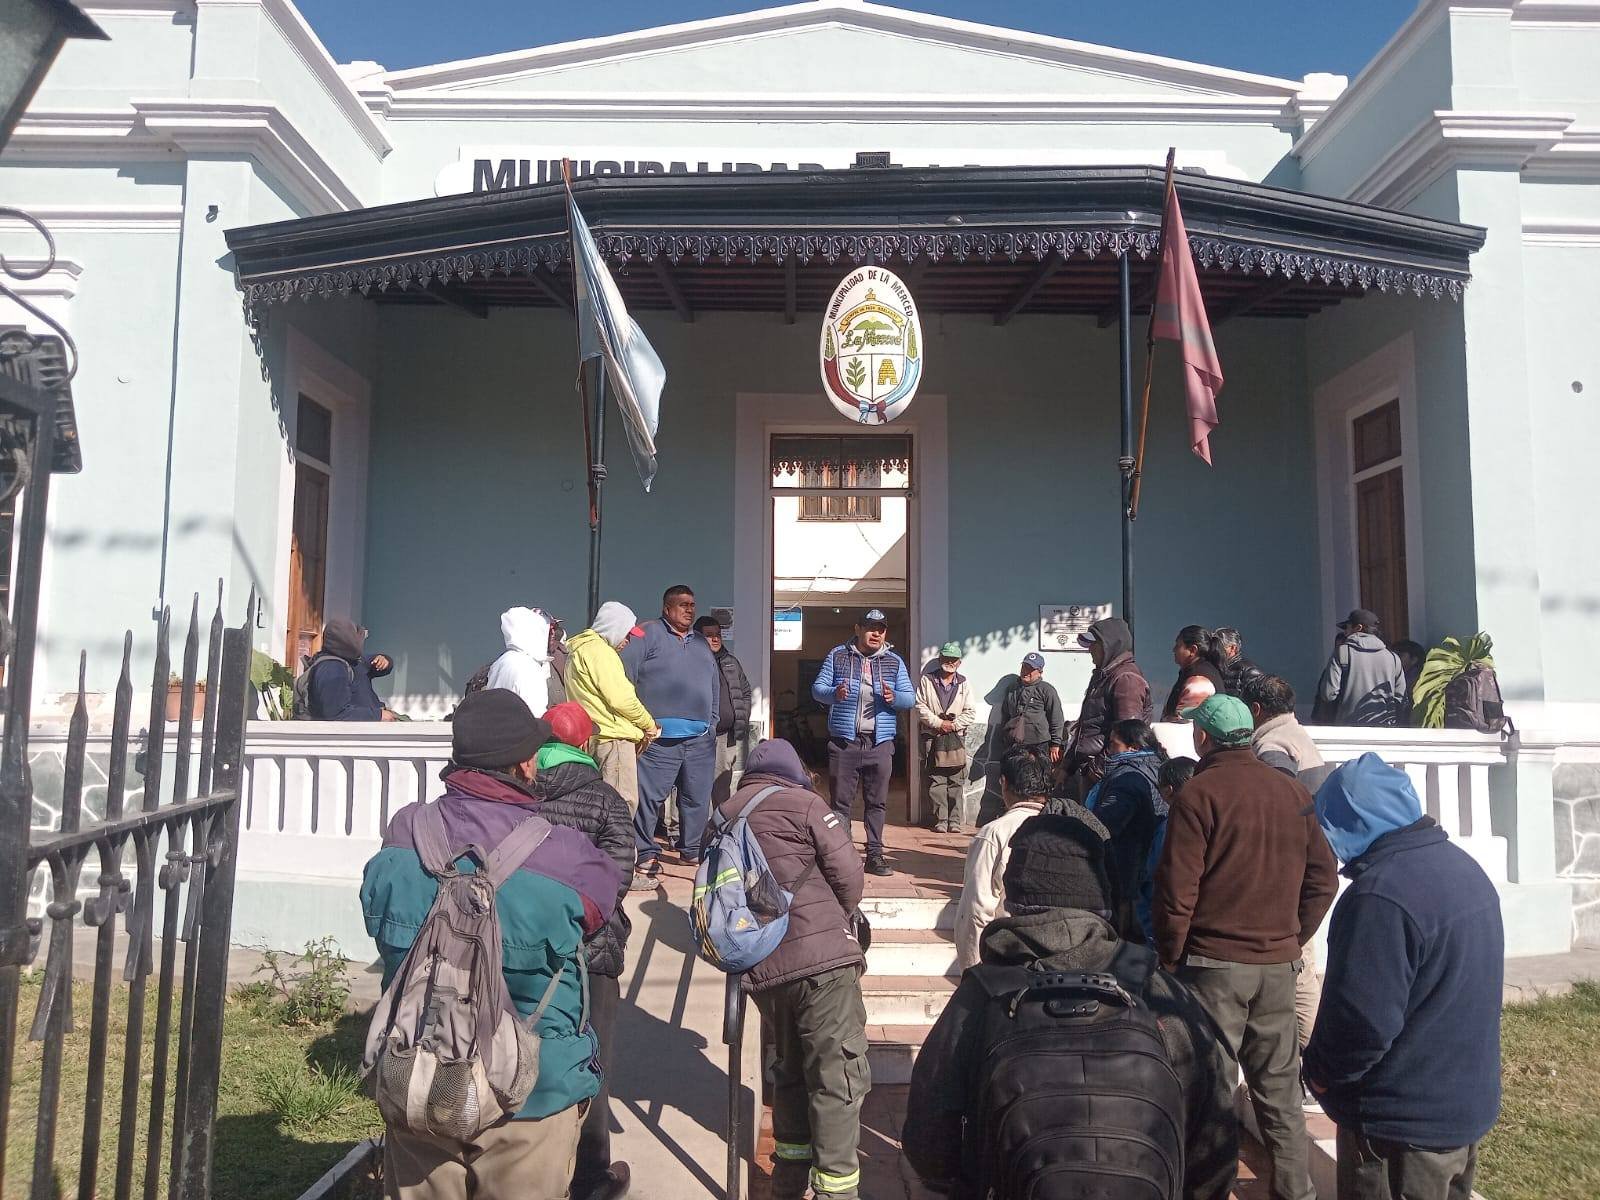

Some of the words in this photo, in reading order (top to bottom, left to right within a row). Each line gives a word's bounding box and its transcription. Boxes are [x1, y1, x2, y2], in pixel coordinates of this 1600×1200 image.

[828, 273, 864, 319] MUNICIPALIDAD
[868, 269, 878, 280] DE
[880, 272, 890, 284] LA
[890, 281, 913, 317] MERCED
